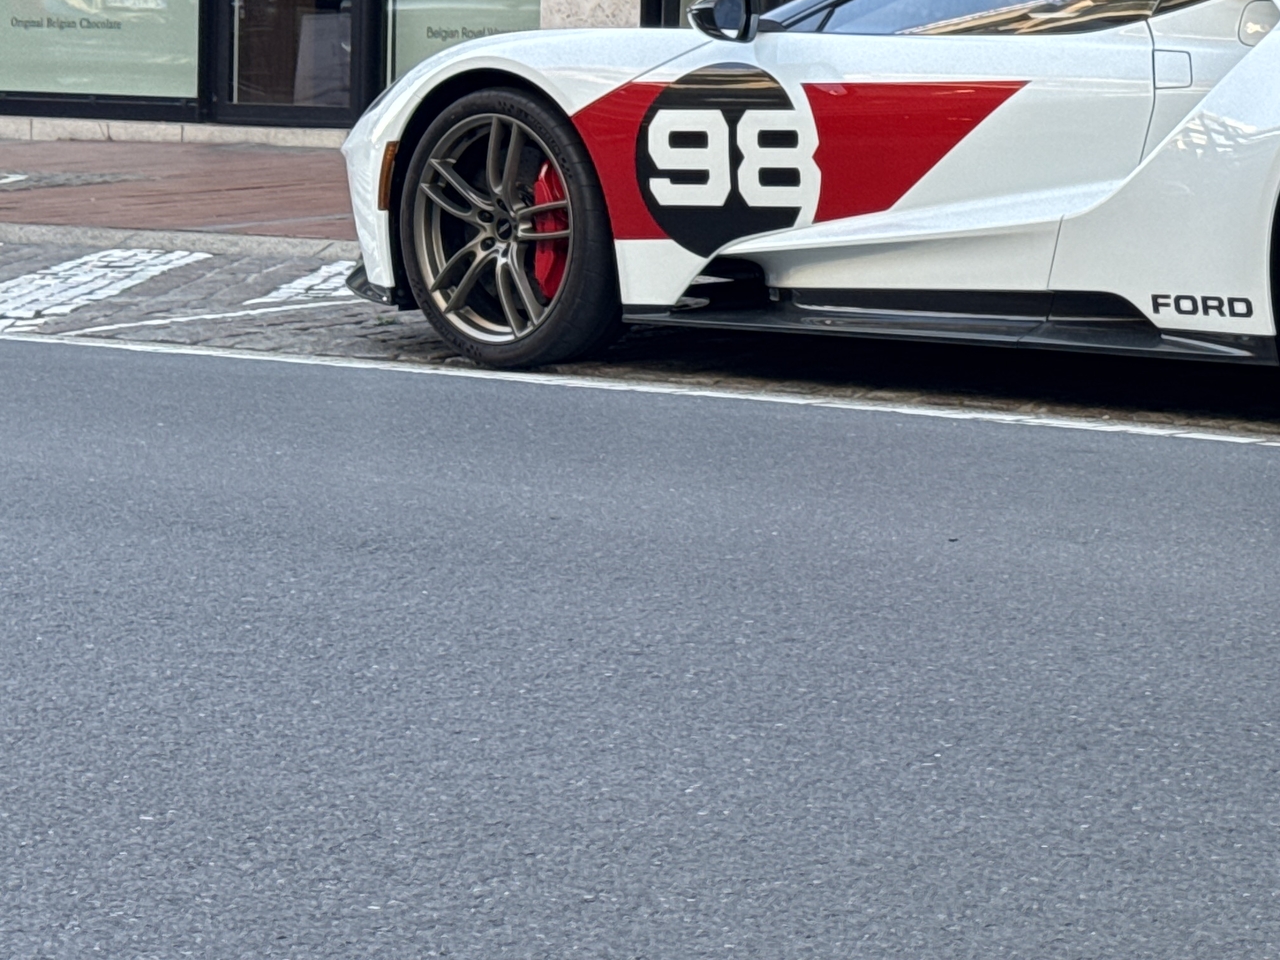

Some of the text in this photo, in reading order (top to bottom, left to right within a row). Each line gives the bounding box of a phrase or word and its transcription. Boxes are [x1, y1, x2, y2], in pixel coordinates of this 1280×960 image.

[10, 16, 122, 30] Original Belgian Chocolate
[426, 26, 460, 42] Belgian
[648, 109, 822, 207] 98
[1151, 294, 1253, 318] FORD
